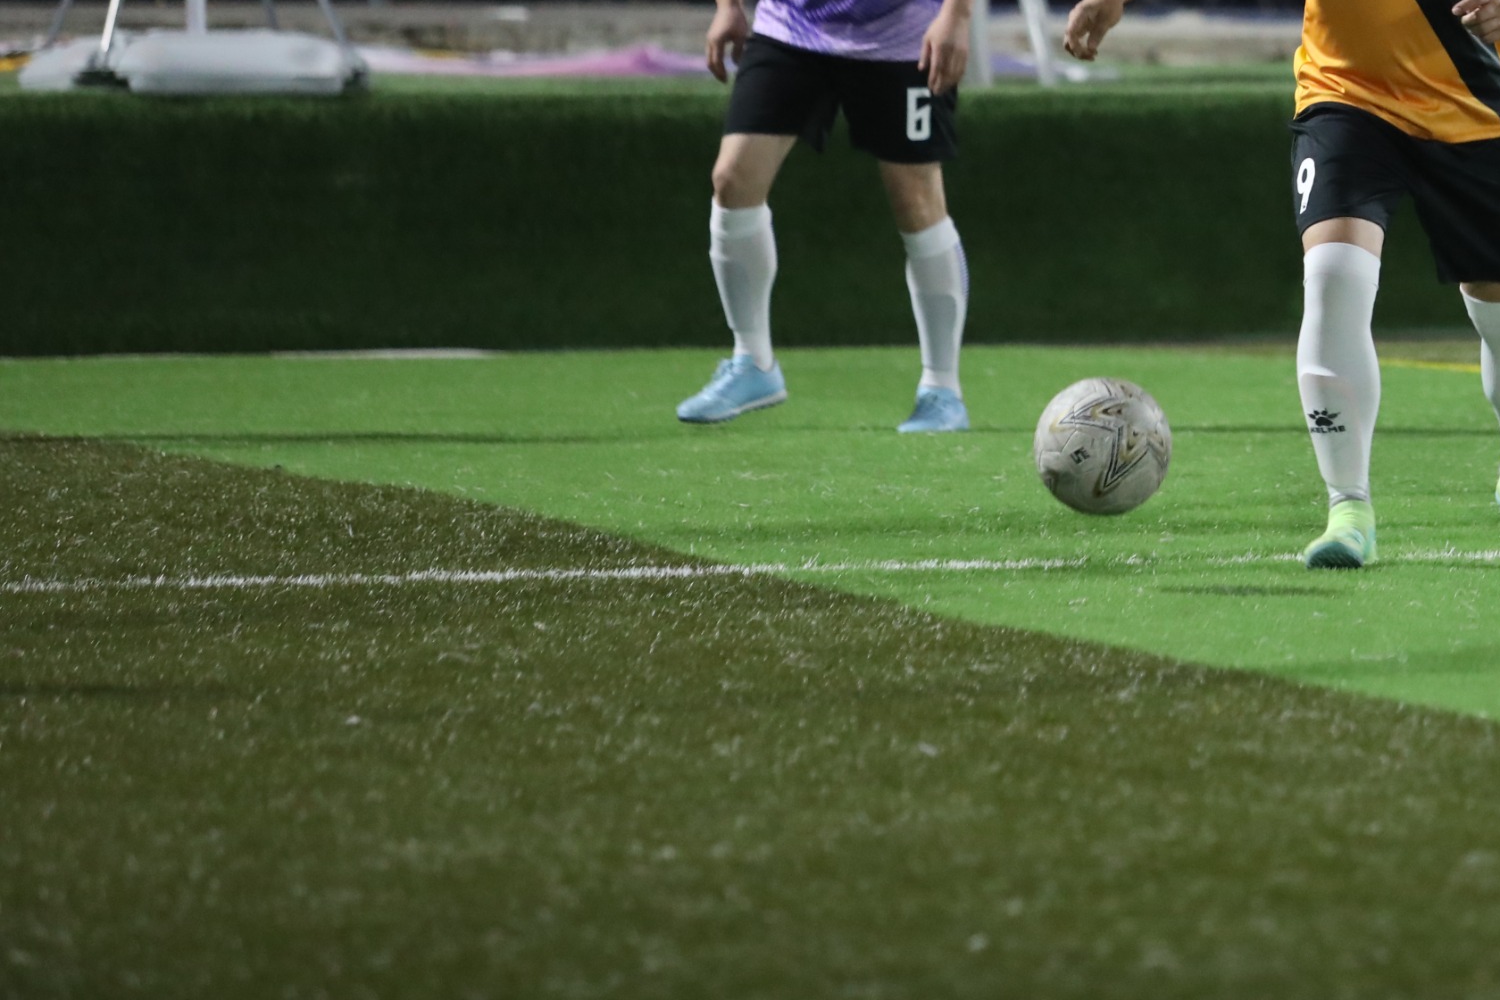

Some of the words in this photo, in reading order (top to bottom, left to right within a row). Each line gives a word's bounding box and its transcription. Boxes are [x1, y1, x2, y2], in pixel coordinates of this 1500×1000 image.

[905, 86, 932, 142] 6
[1296, 157, 1316, 215] 9
[1310, 425, 1346, 434] KELME
